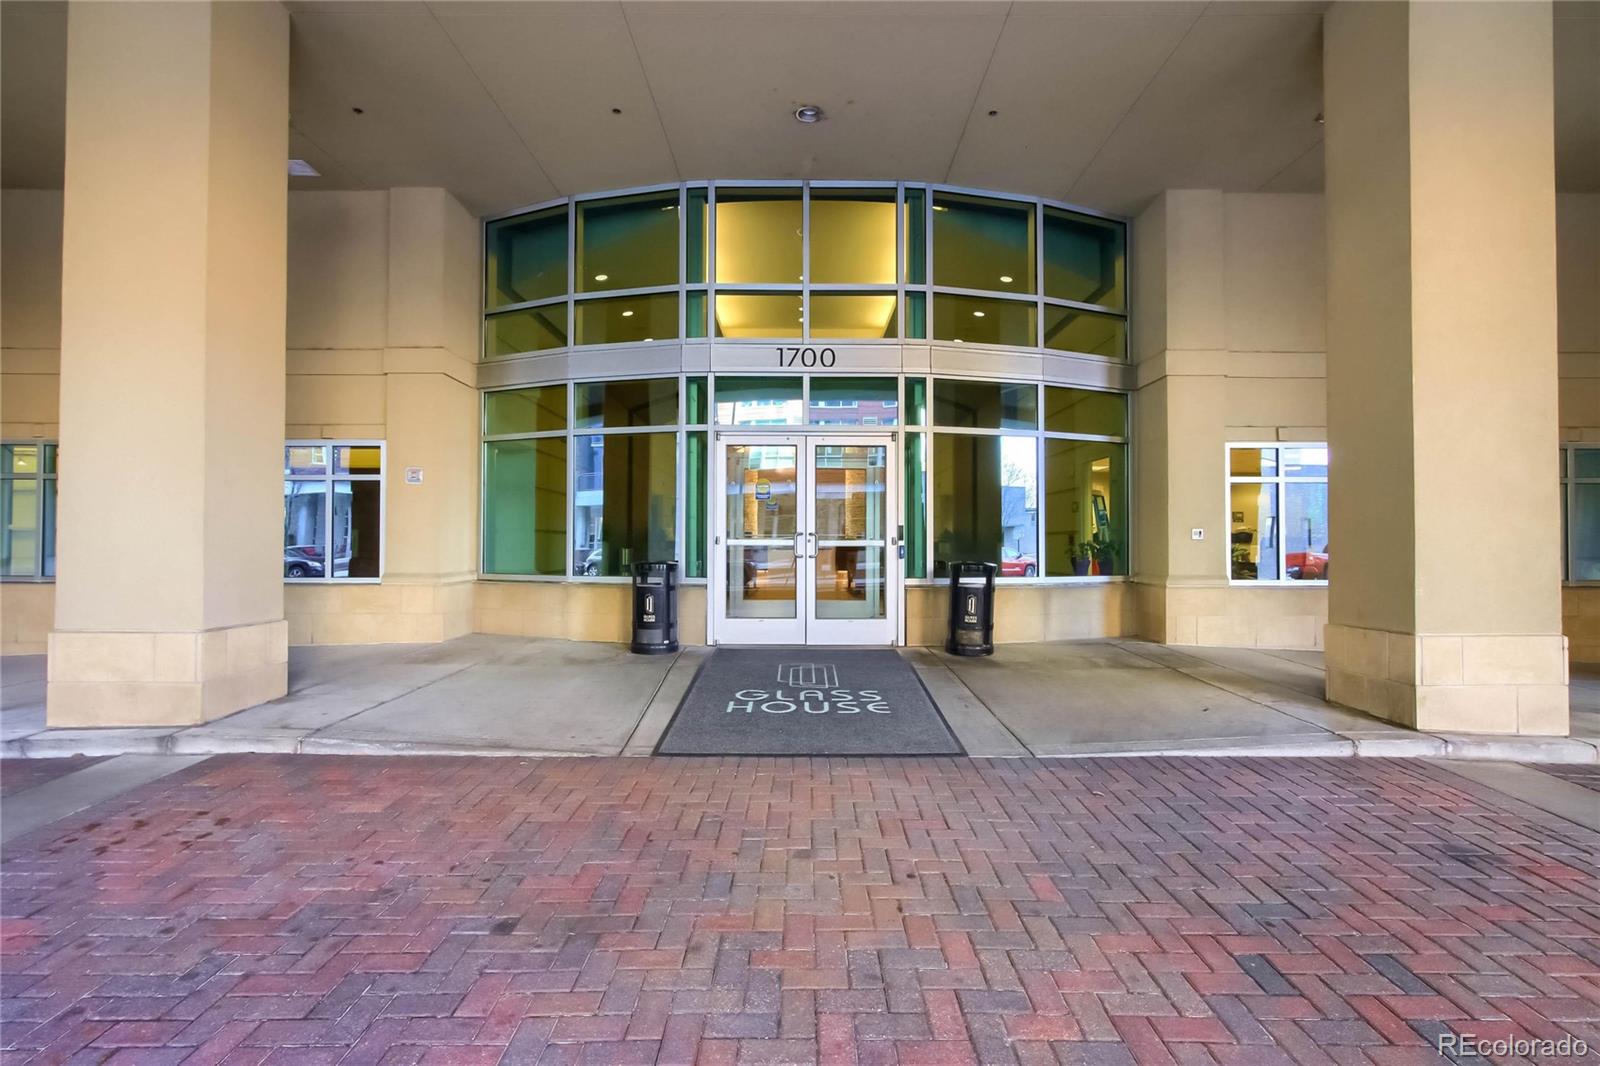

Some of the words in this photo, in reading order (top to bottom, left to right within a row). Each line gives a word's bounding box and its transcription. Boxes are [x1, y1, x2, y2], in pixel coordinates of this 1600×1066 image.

[776, 347, 836, 367] 1700
[735, 689, 882, 701] GLASS
[726, 701, 892, 713] HOUSE
